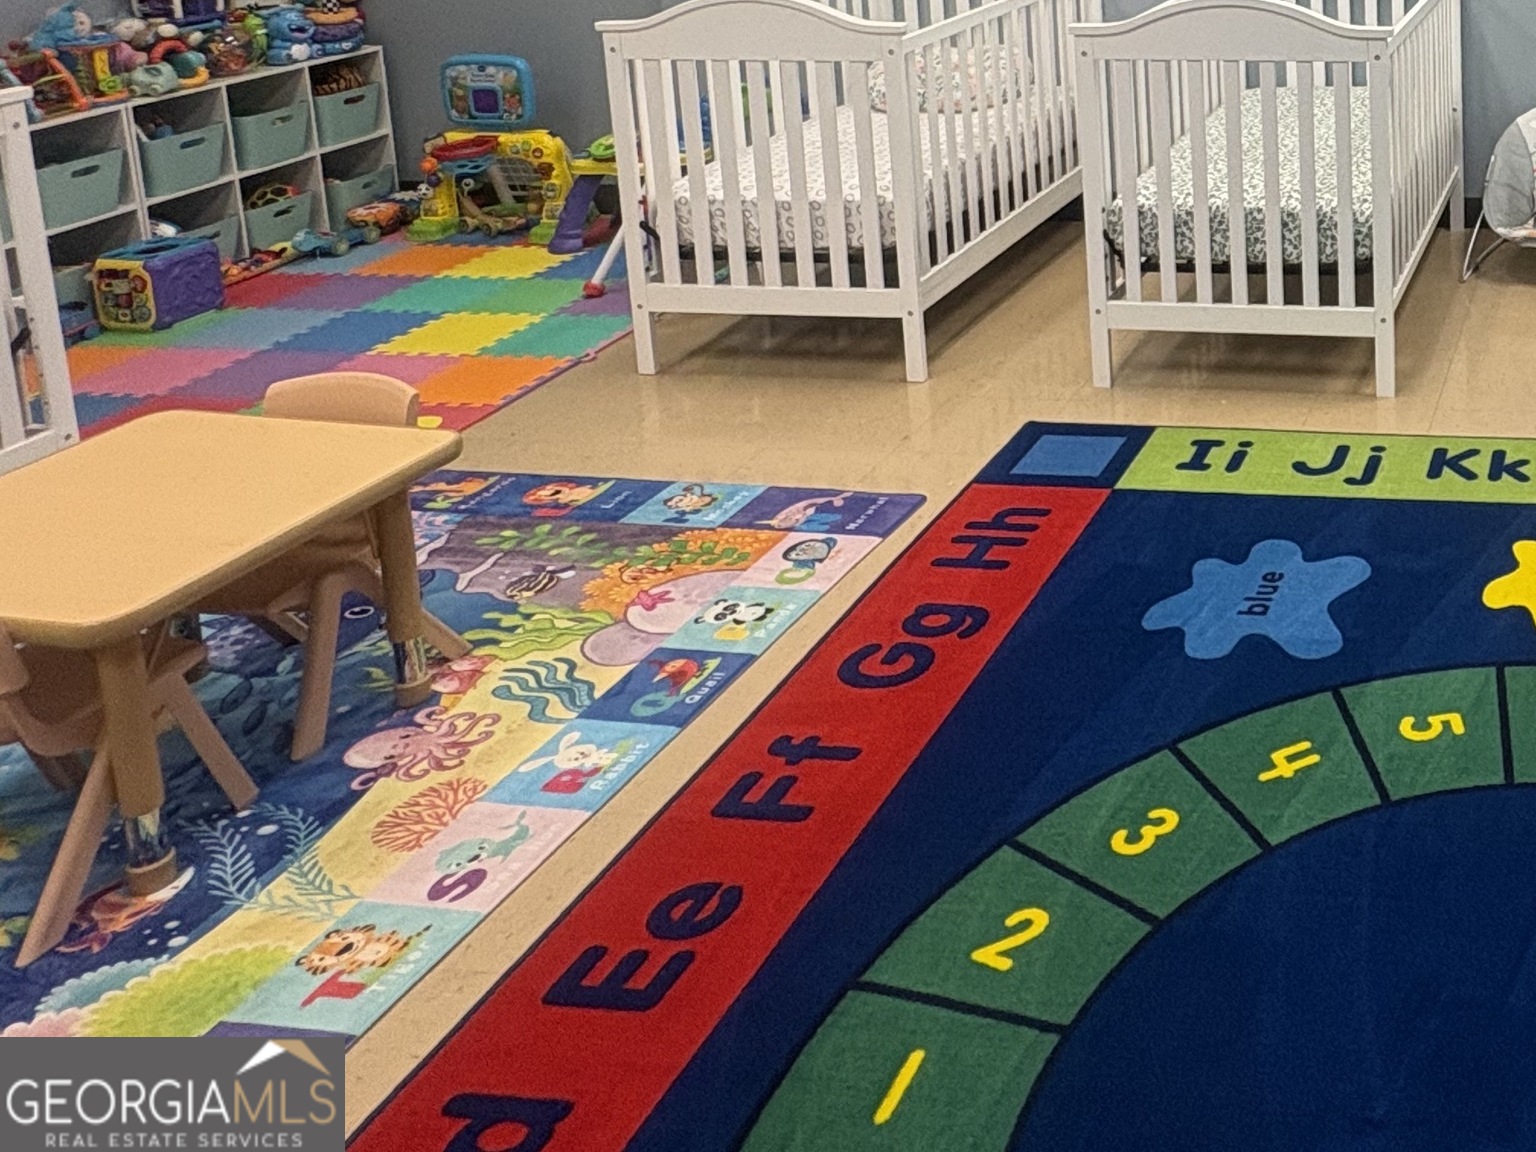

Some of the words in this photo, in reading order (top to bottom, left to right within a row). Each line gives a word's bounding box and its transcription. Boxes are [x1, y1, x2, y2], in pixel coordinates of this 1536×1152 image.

[1176, 439, 1255, 473] Ii
[1290, 444, 1388, 487] Jj
[1425, 447, 1532, 483] Kk
[931, 506, 1053, 570] Hh
[1236, 571, 1285, 616] blue
[836, 602, 990, 689] Gg
[684, 671, 726, 705] Quail
[1399, 711, 1466, 742] 5
[540, 766, 602, 795] R
[589, 740, 651, 791] Rabbit
[711, 734, 863, 822] Ff
[1258, 740, 1321, 782] 4
[1110, 808, 1180, 855] 3
[426, 867, 488, 904] S
[541, 880, 744, 1013] Ee
[971, 907, 1050, 971] 2
[300, 968, 368, 1009] T
[873, 1049, 926, 1125] 1
[441, 1092, 576, 1152] d
